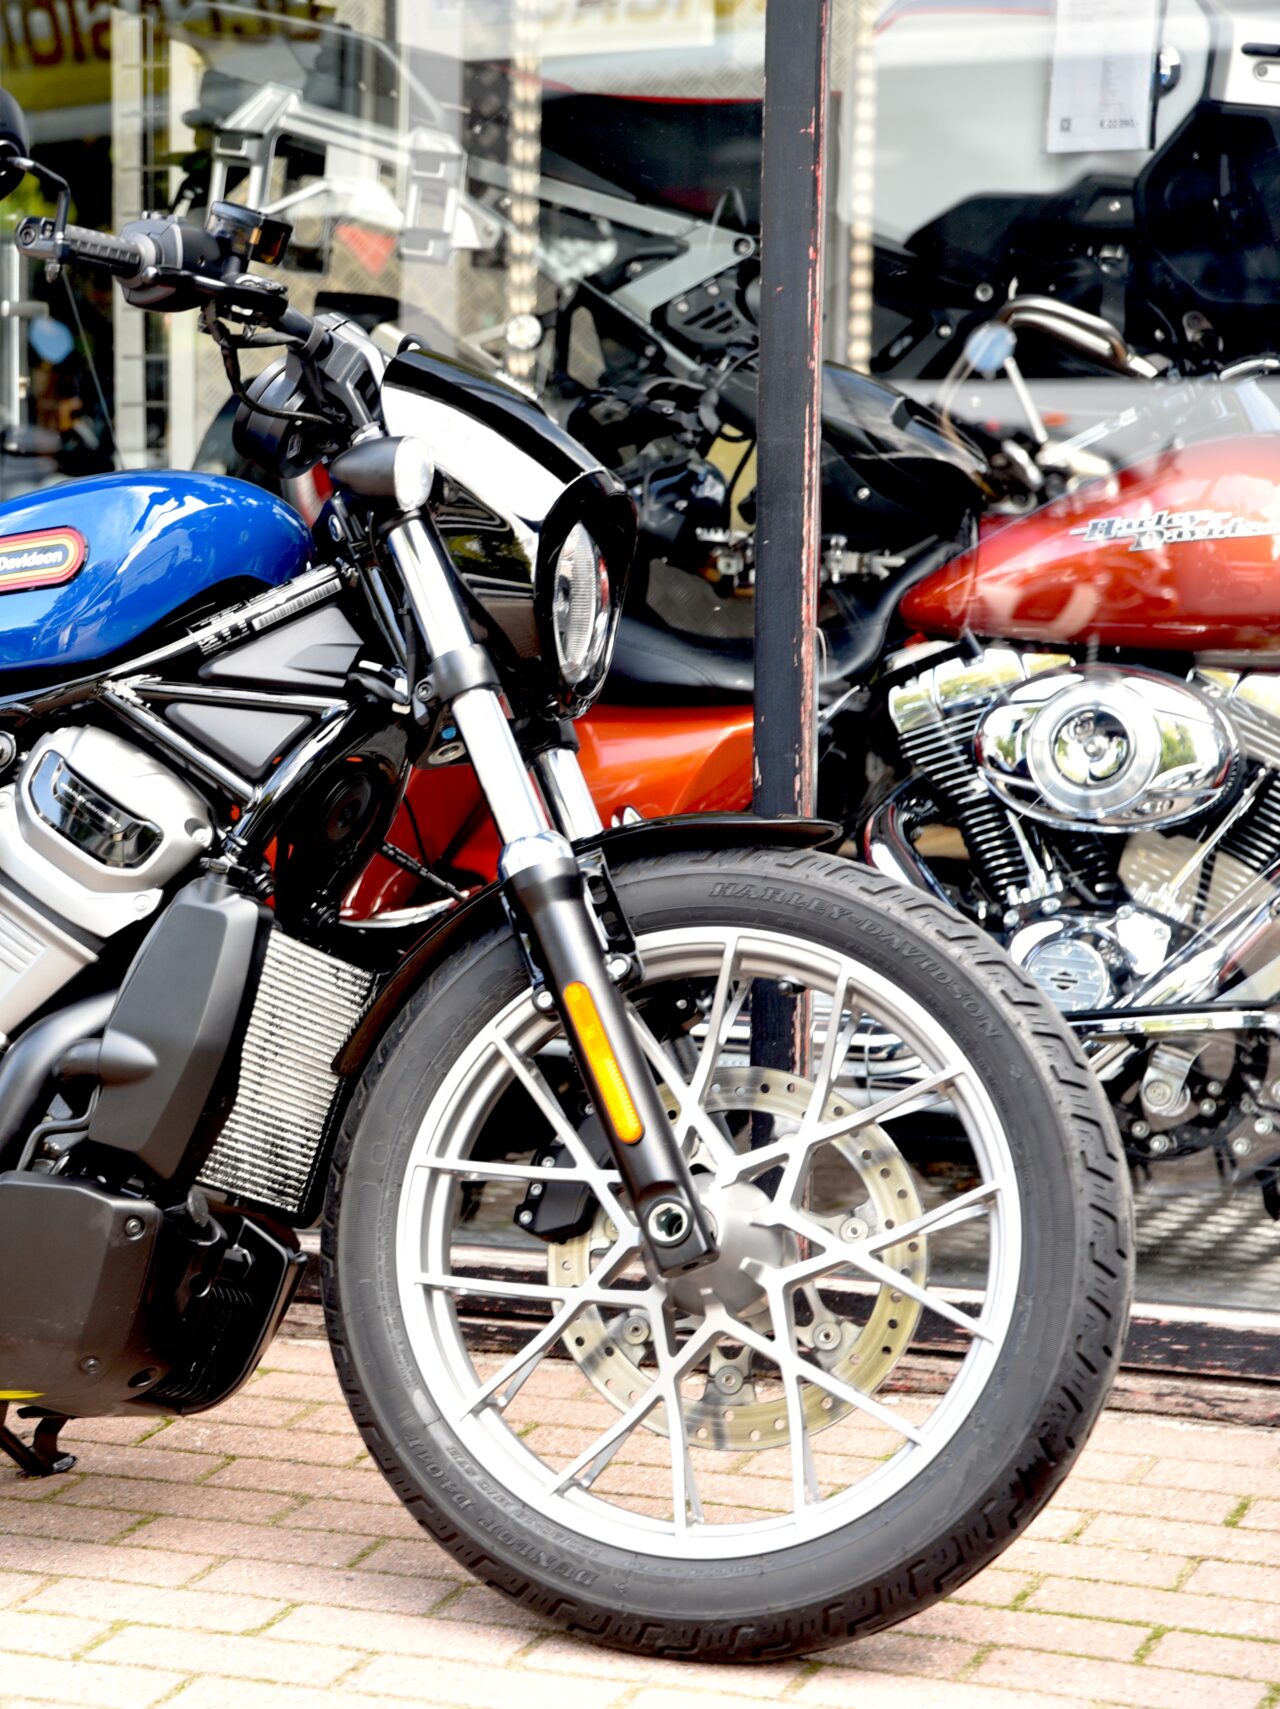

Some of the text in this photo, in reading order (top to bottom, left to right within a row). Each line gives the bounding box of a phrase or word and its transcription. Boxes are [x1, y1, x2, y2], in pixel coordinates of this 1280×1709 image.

[1081, 509, 1202, 541] Harley
[709, 881, 1005, 1040] HARLEY-DAVIDSON
[477, 1517, 600, 1587] DUNLOP
